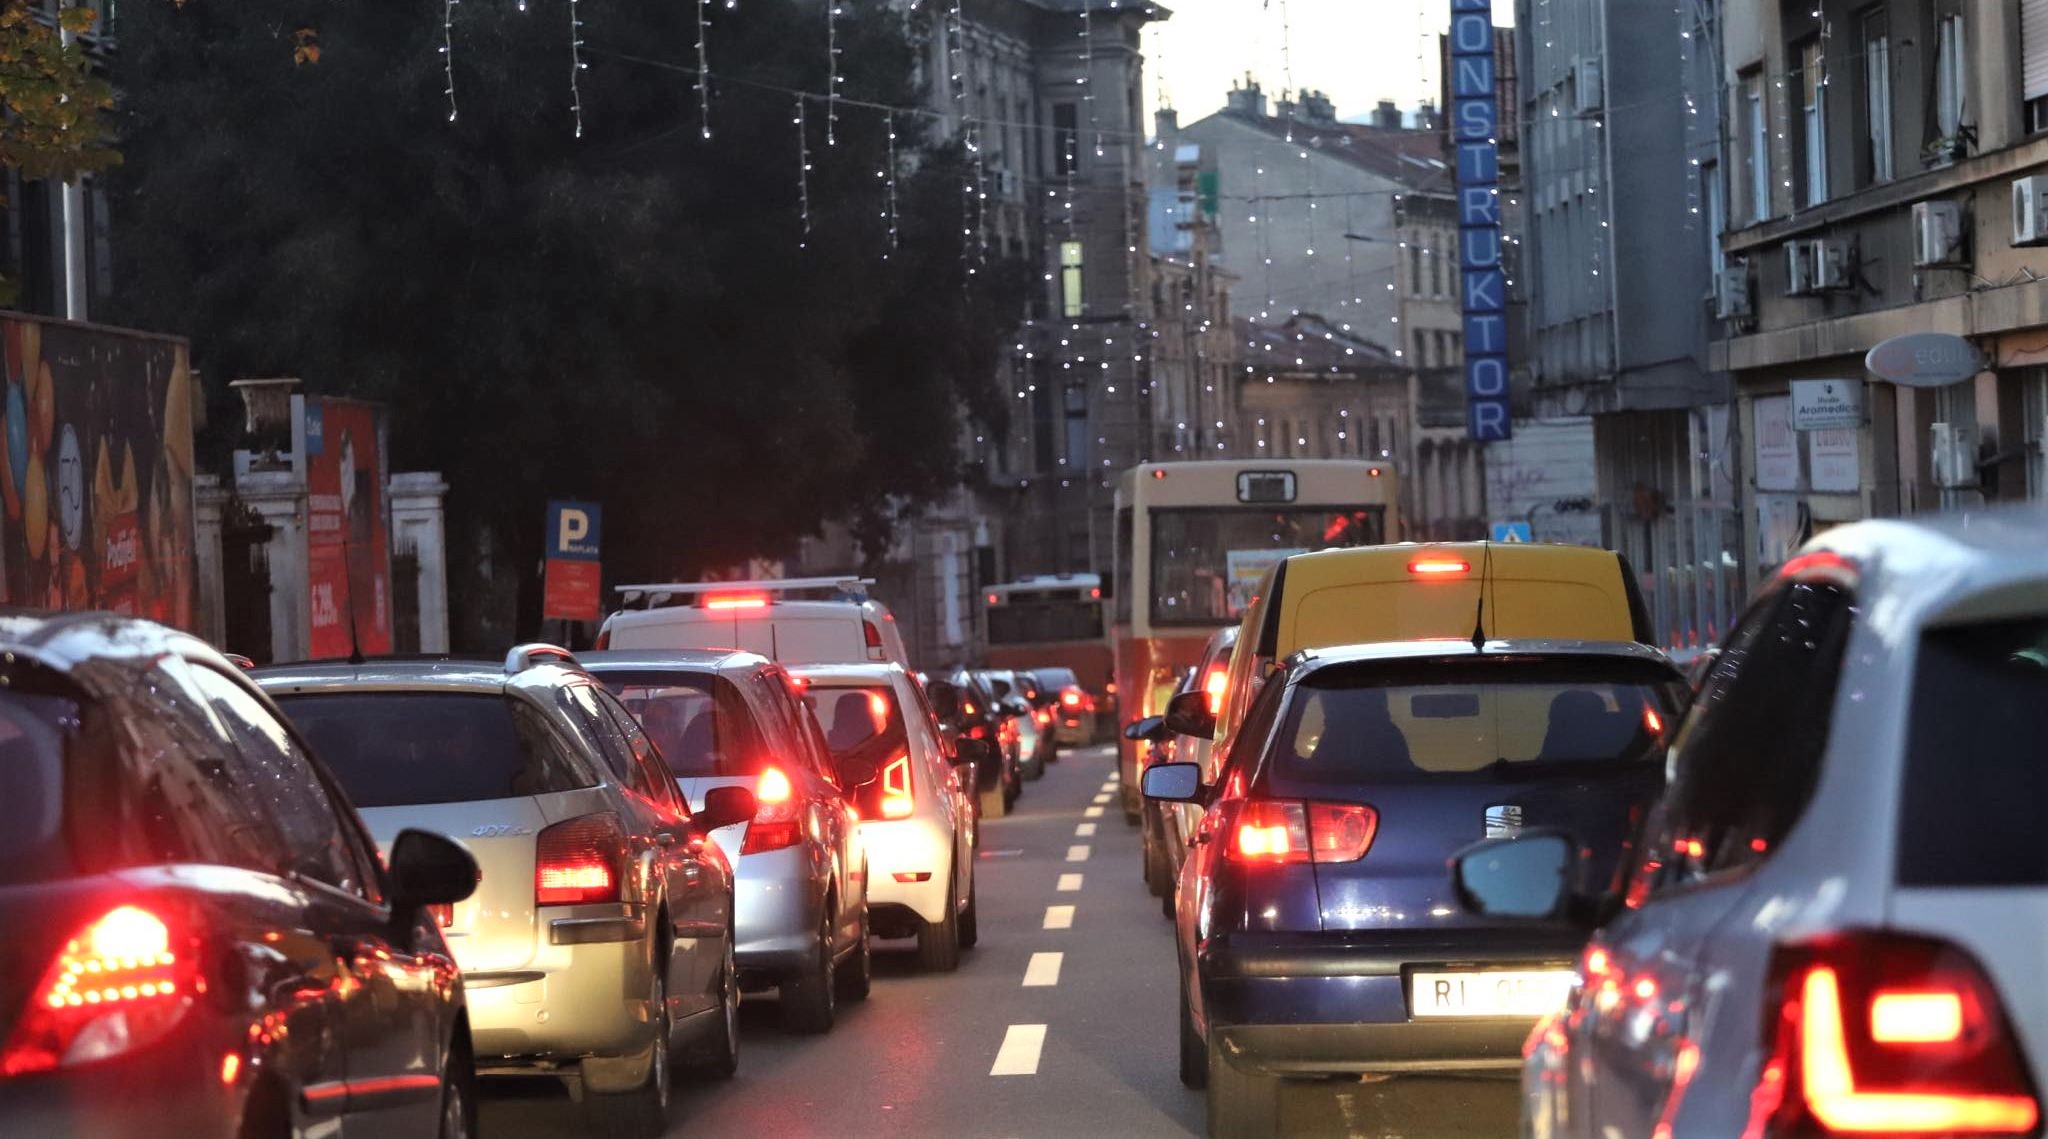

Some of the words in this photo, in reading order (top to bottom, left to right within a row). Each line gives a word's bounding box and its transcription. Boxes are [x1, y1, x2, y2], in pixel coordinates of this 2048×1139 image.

[1456, 0, 1505, 438] ONSTRUKTOR
[1799, 403, 1860, 415] Aromedica
[559, 508, 588, 551] P
